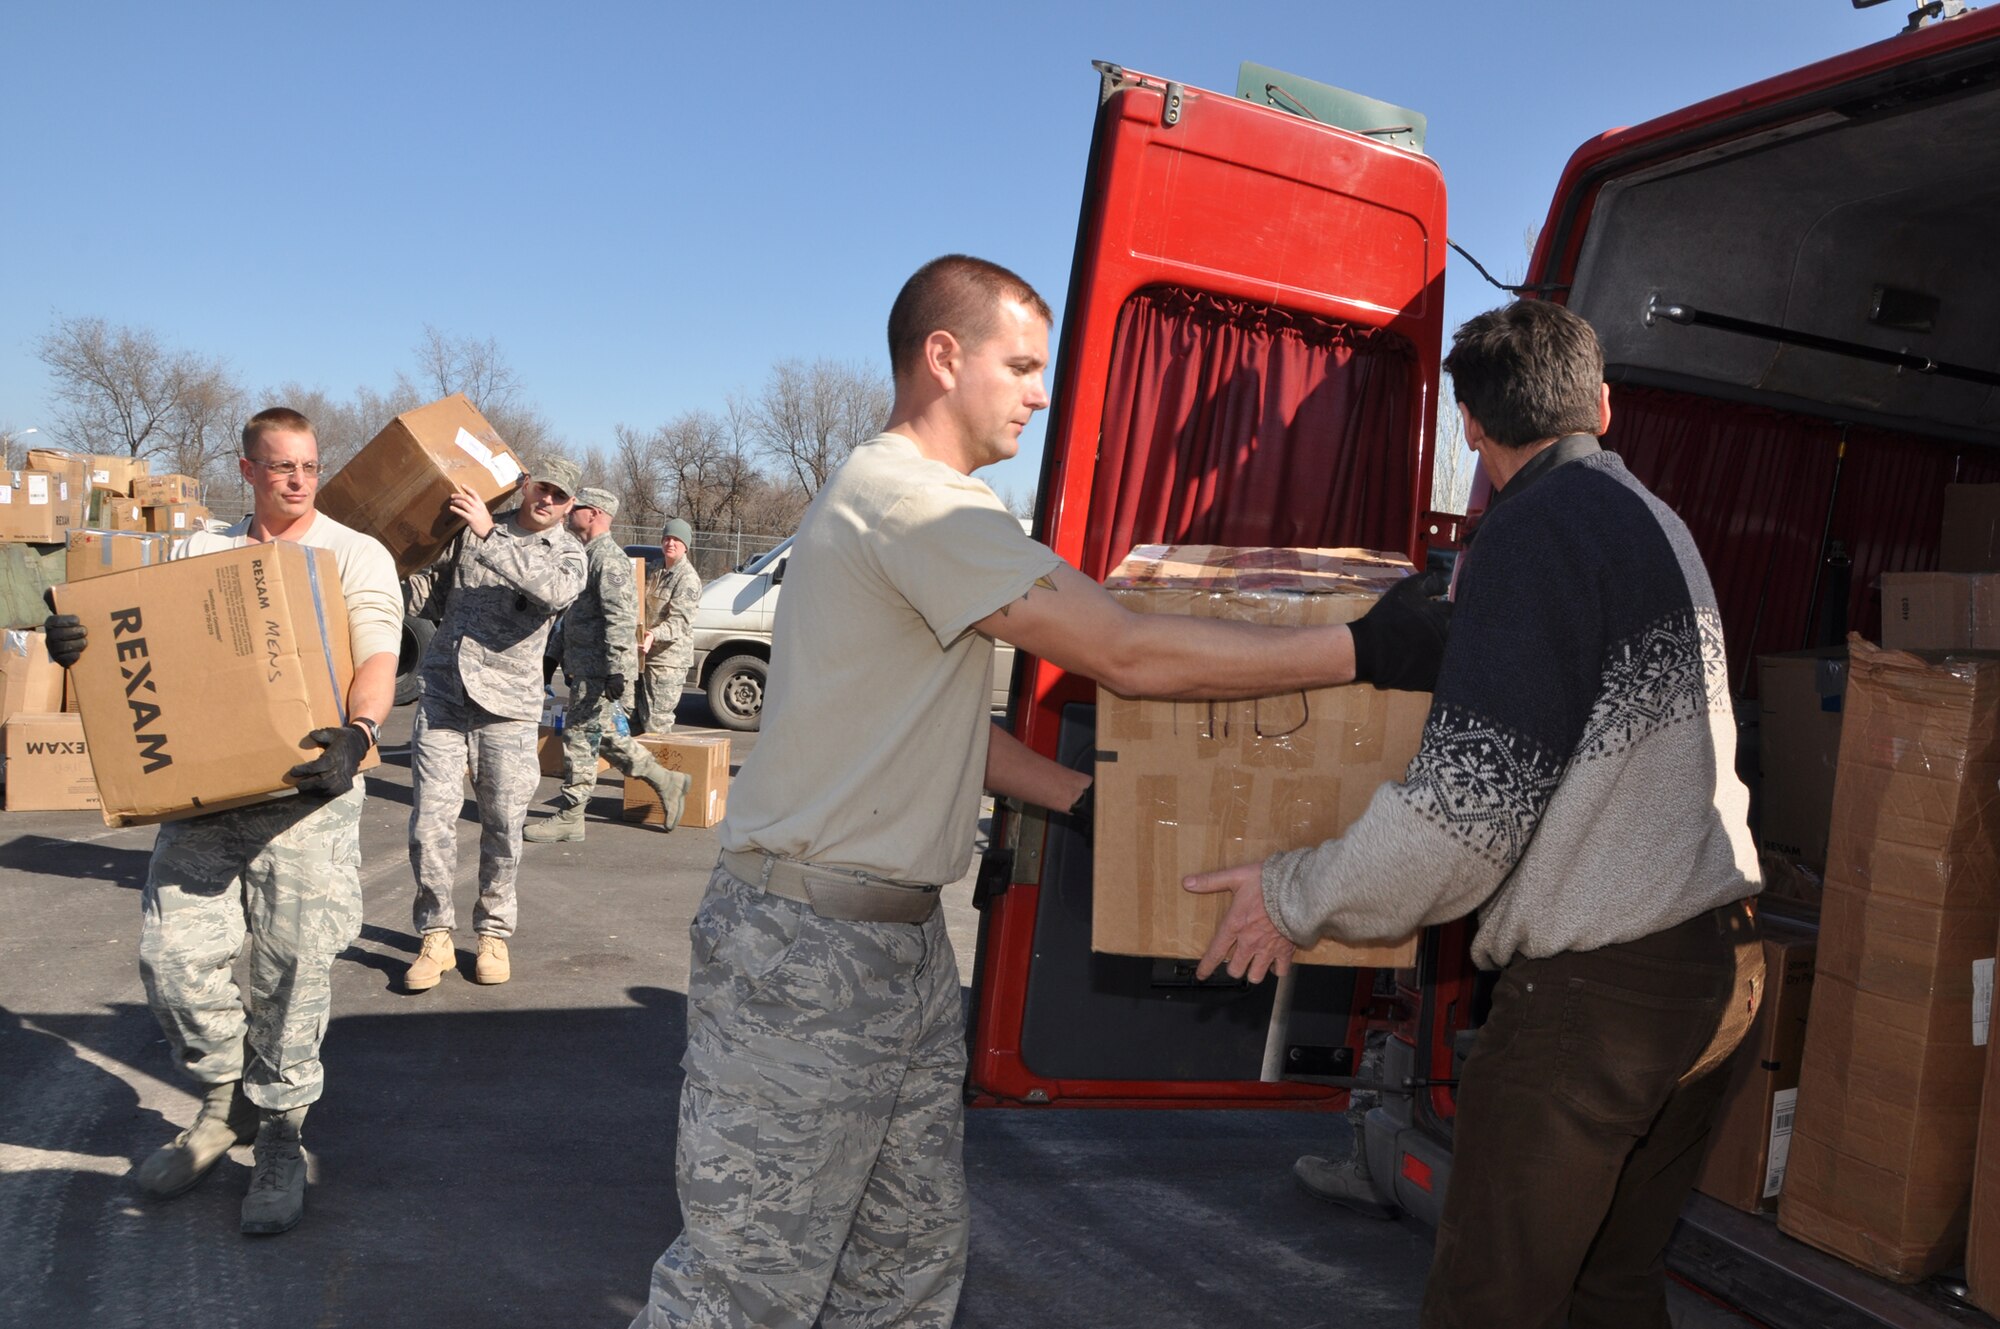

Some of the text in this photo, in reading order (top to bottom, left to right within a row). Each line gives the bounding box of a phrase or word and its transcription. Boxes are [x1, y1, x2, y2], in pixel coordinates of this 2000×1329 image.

[252, 559, 270, 609] REXAM
[265, 620, 282, 683] MENS
[110, 607, 173, 775] REXAM
[26, 742, 86, 754] EXAM
[1764, 840, 1801, 856] REXAM
